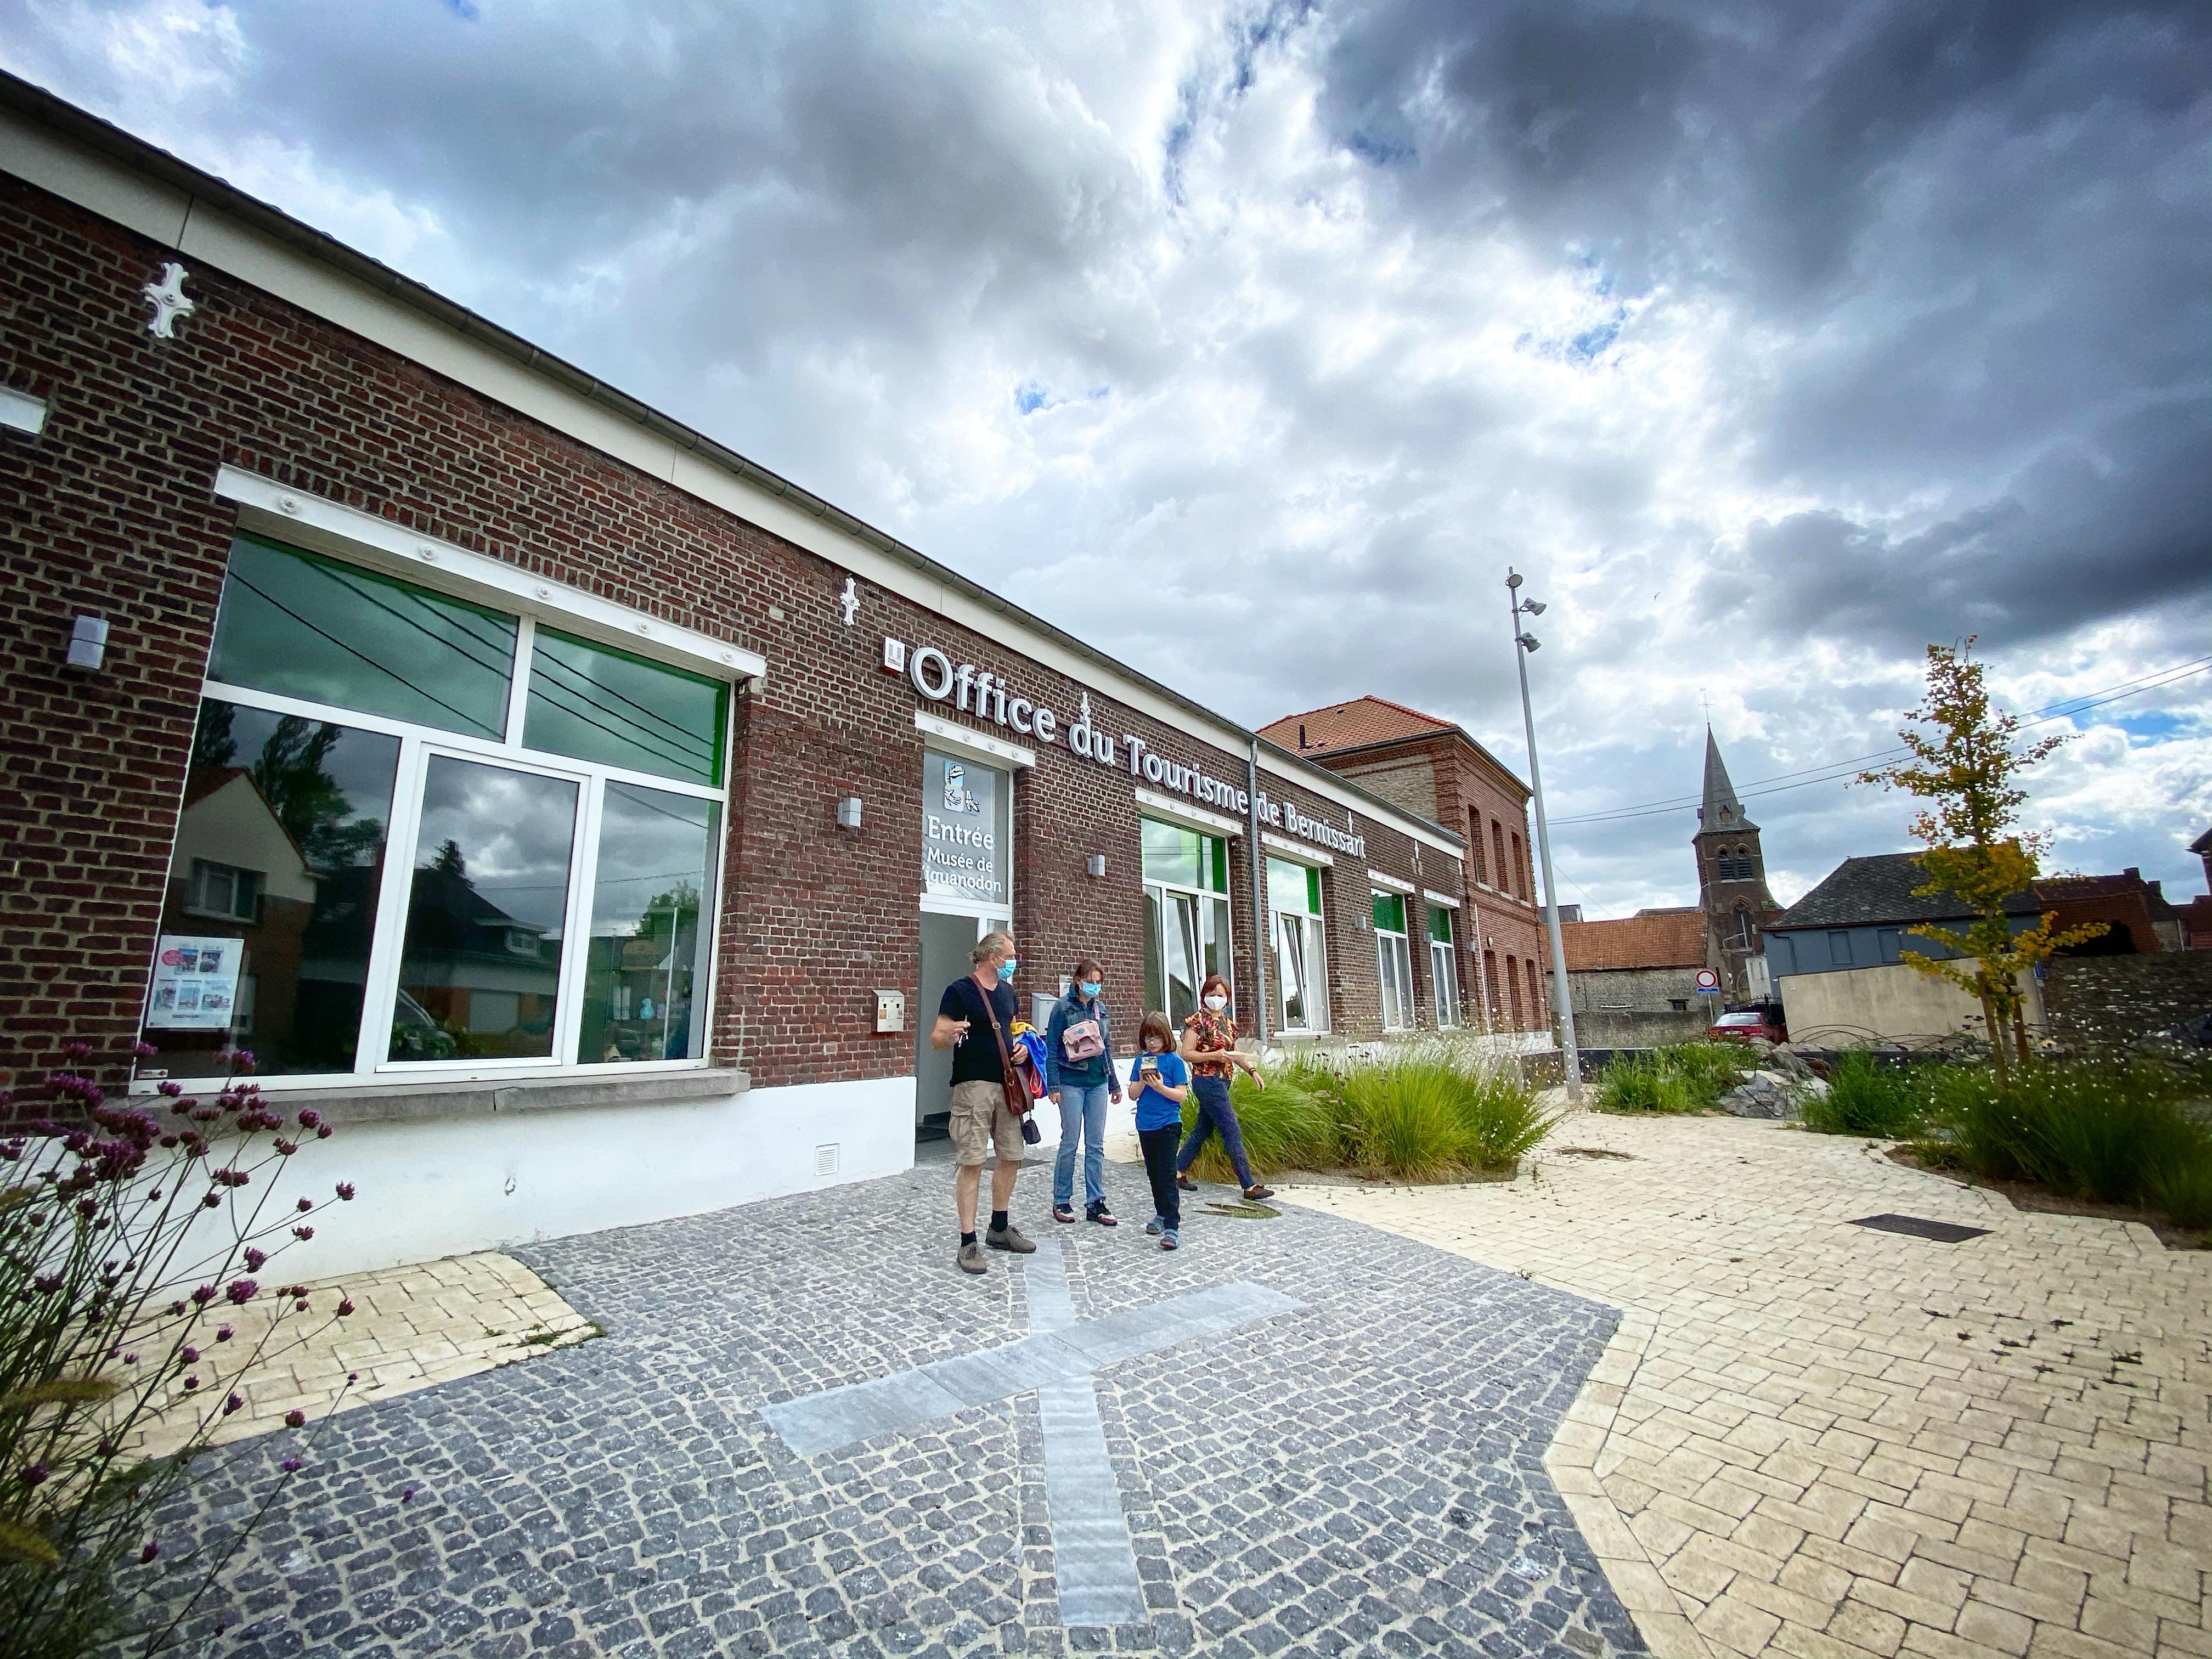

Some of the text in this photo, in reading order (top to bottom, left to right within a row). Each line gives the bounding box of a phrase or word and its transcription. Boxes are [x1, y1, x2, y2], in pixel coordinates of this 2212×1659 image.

[910, 647, 1366, 859] Office du Tourisme de Bernissart
[927, 815, 994, 850] Entrée
[927, 847, 993, 873] Musée de
[922, 865, 1002, 893] 'iguanodon
